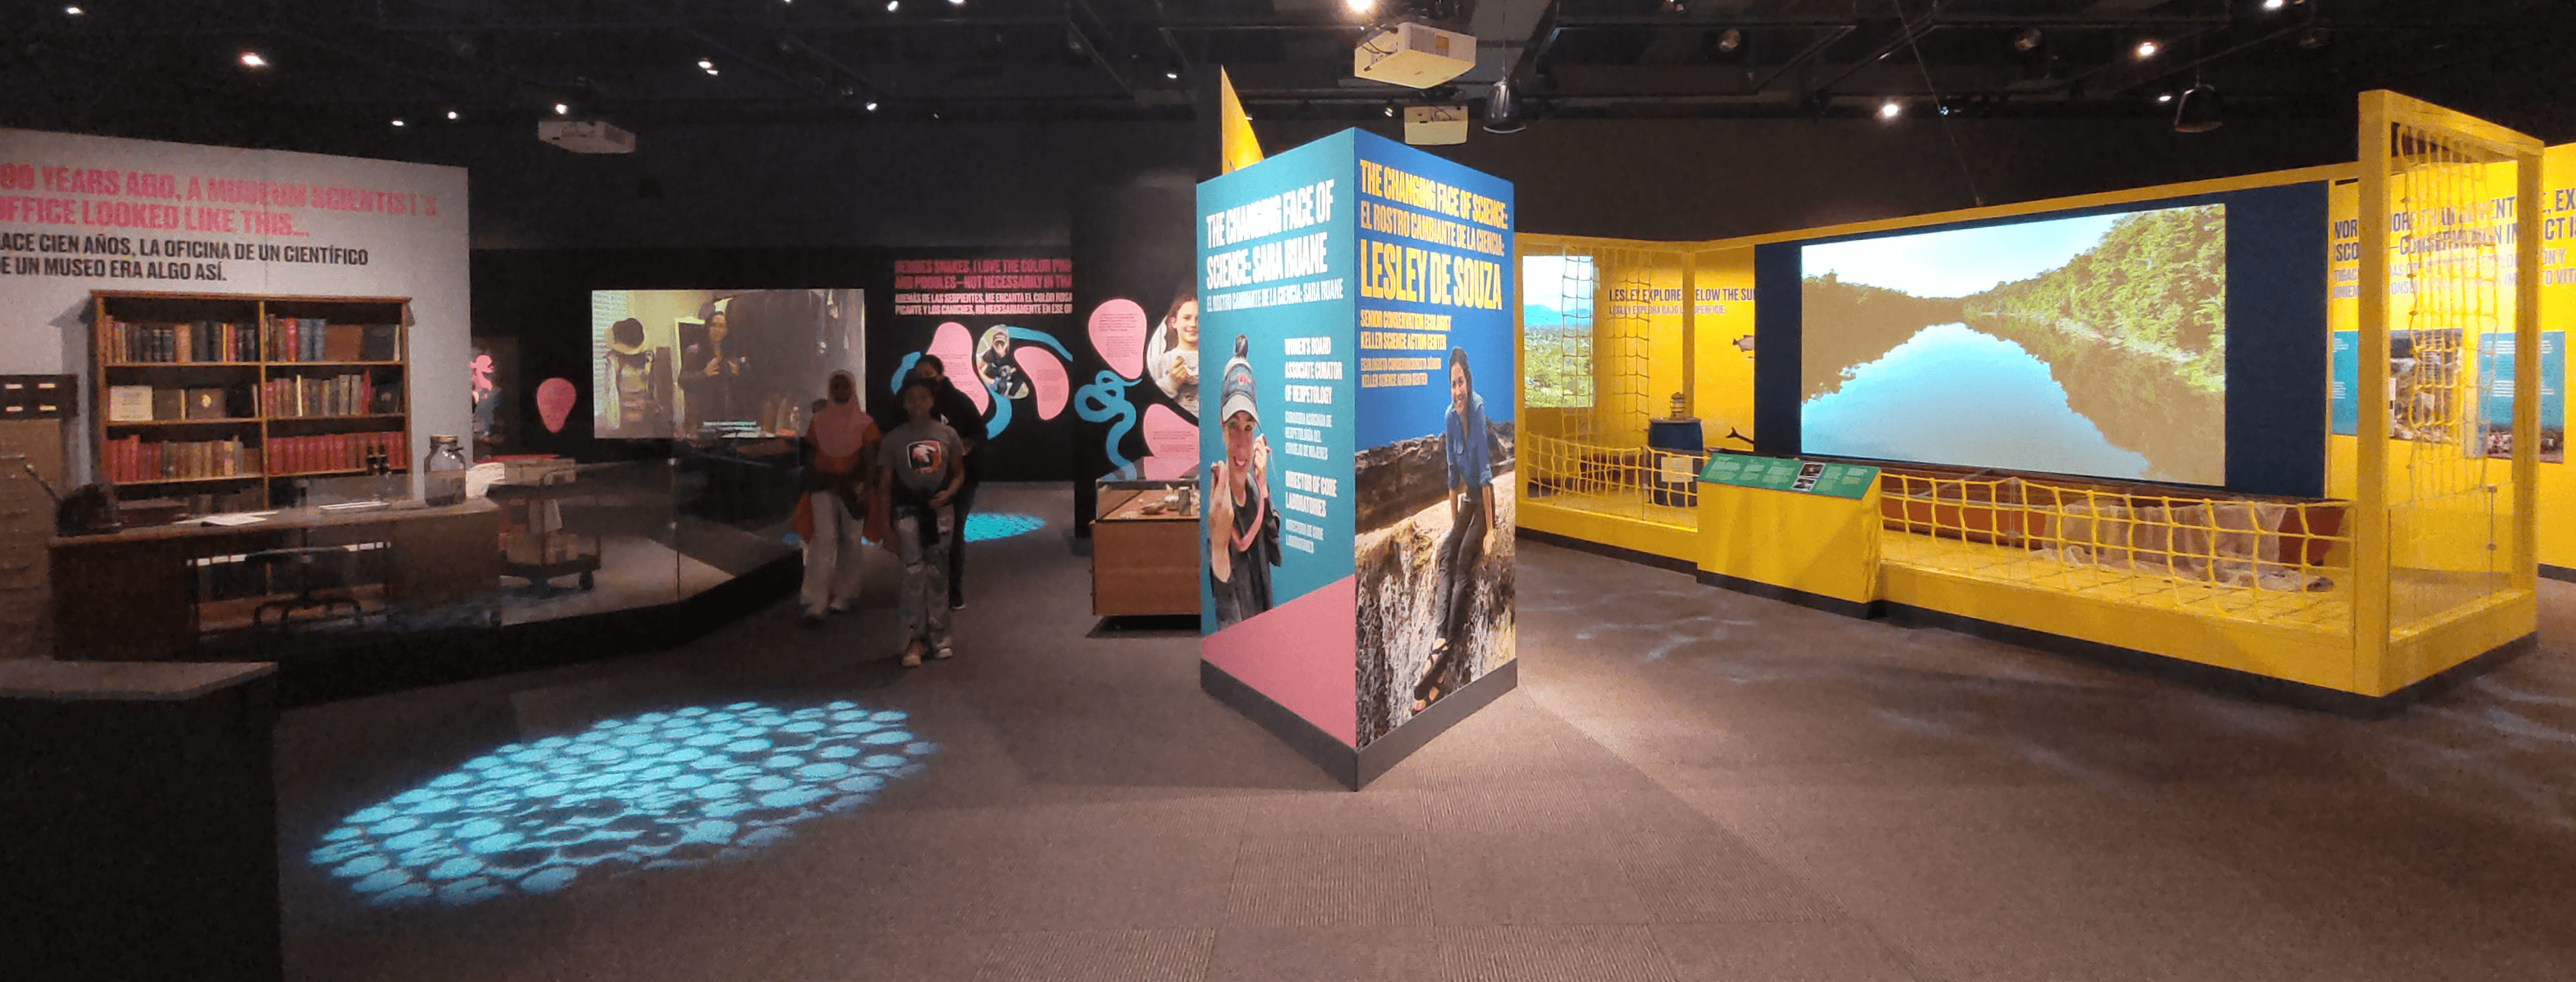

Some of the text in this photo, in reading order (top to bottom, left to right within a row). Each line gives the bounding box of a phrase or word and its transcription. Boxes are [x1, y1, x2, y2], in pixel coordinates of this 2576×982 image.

[40, 166, 120, 196] YEARS
[186, 175, 203, 201] A
[207, 178, 306, 207] MUSEUM
[1360, 159, 1509, 230] THE CHANGING FACE OF SCIENCE:
[81, 199, 179, 230] LOOKED
[184, 207, 235, 232] LIKE
[1206, 178, 1335, 249] THE CHANGING FACE OF
[1360, 200, 1372, 230] EL
[1373, 203, 1410, 237] ROSTRO
[1411, 212, 1456, 246] CAMBIANTE
[1456, 223, 1467, 249] DE
[1467, 225, 1476, 251] LA
[0, 233, 369, 266] ACE CIEN AÑOS, LA OFICINA DE UN CIENTÍFICO
[1207, 231, 1328, 291] SCIENCE: SARA RUANE
[0, 256, 228, 282] E UN MUSEO ERA ALGO ASÍ.
[977, 260, 1001, 274] LOVE
[1003, 260, 1019, 273] THE
[1020, 260, 1051, 273] COLOR
[1360, 239, 1503, 310] LESLEY DE SOUZA
[983, 275, 1043, 289] NECESSARILY
[1044, 275, 1054, 289] IN
[1642, 288, 1683, 302] EXPLORE
[1693, 288, 1721, 301] ELOW
[1722, 287, 1739, 301] THE
[1207, 295, 1213, 313] EL
[1303, 281, 1321, 303] SARA
[1321, 278, 1344, 301] RUANE
[1360, 309, 1383, 328] SENIOR
[1383, 310, 1424, 331] CONSERVATION
[1285, 336, 1332, 356] WOMEN'S BOARD
[1360, 331, 1447, 351] KELLER SCIENCE ACTION CENTER
[1285, 361, 1343, 380] ASSOCIATE CURATOR
[1285, 384, 1333, 405] OF HERPETOLOGY
[1285, 470, 1312, 492] DIRECTOR
[1312, 475, 1321, 494] OF
